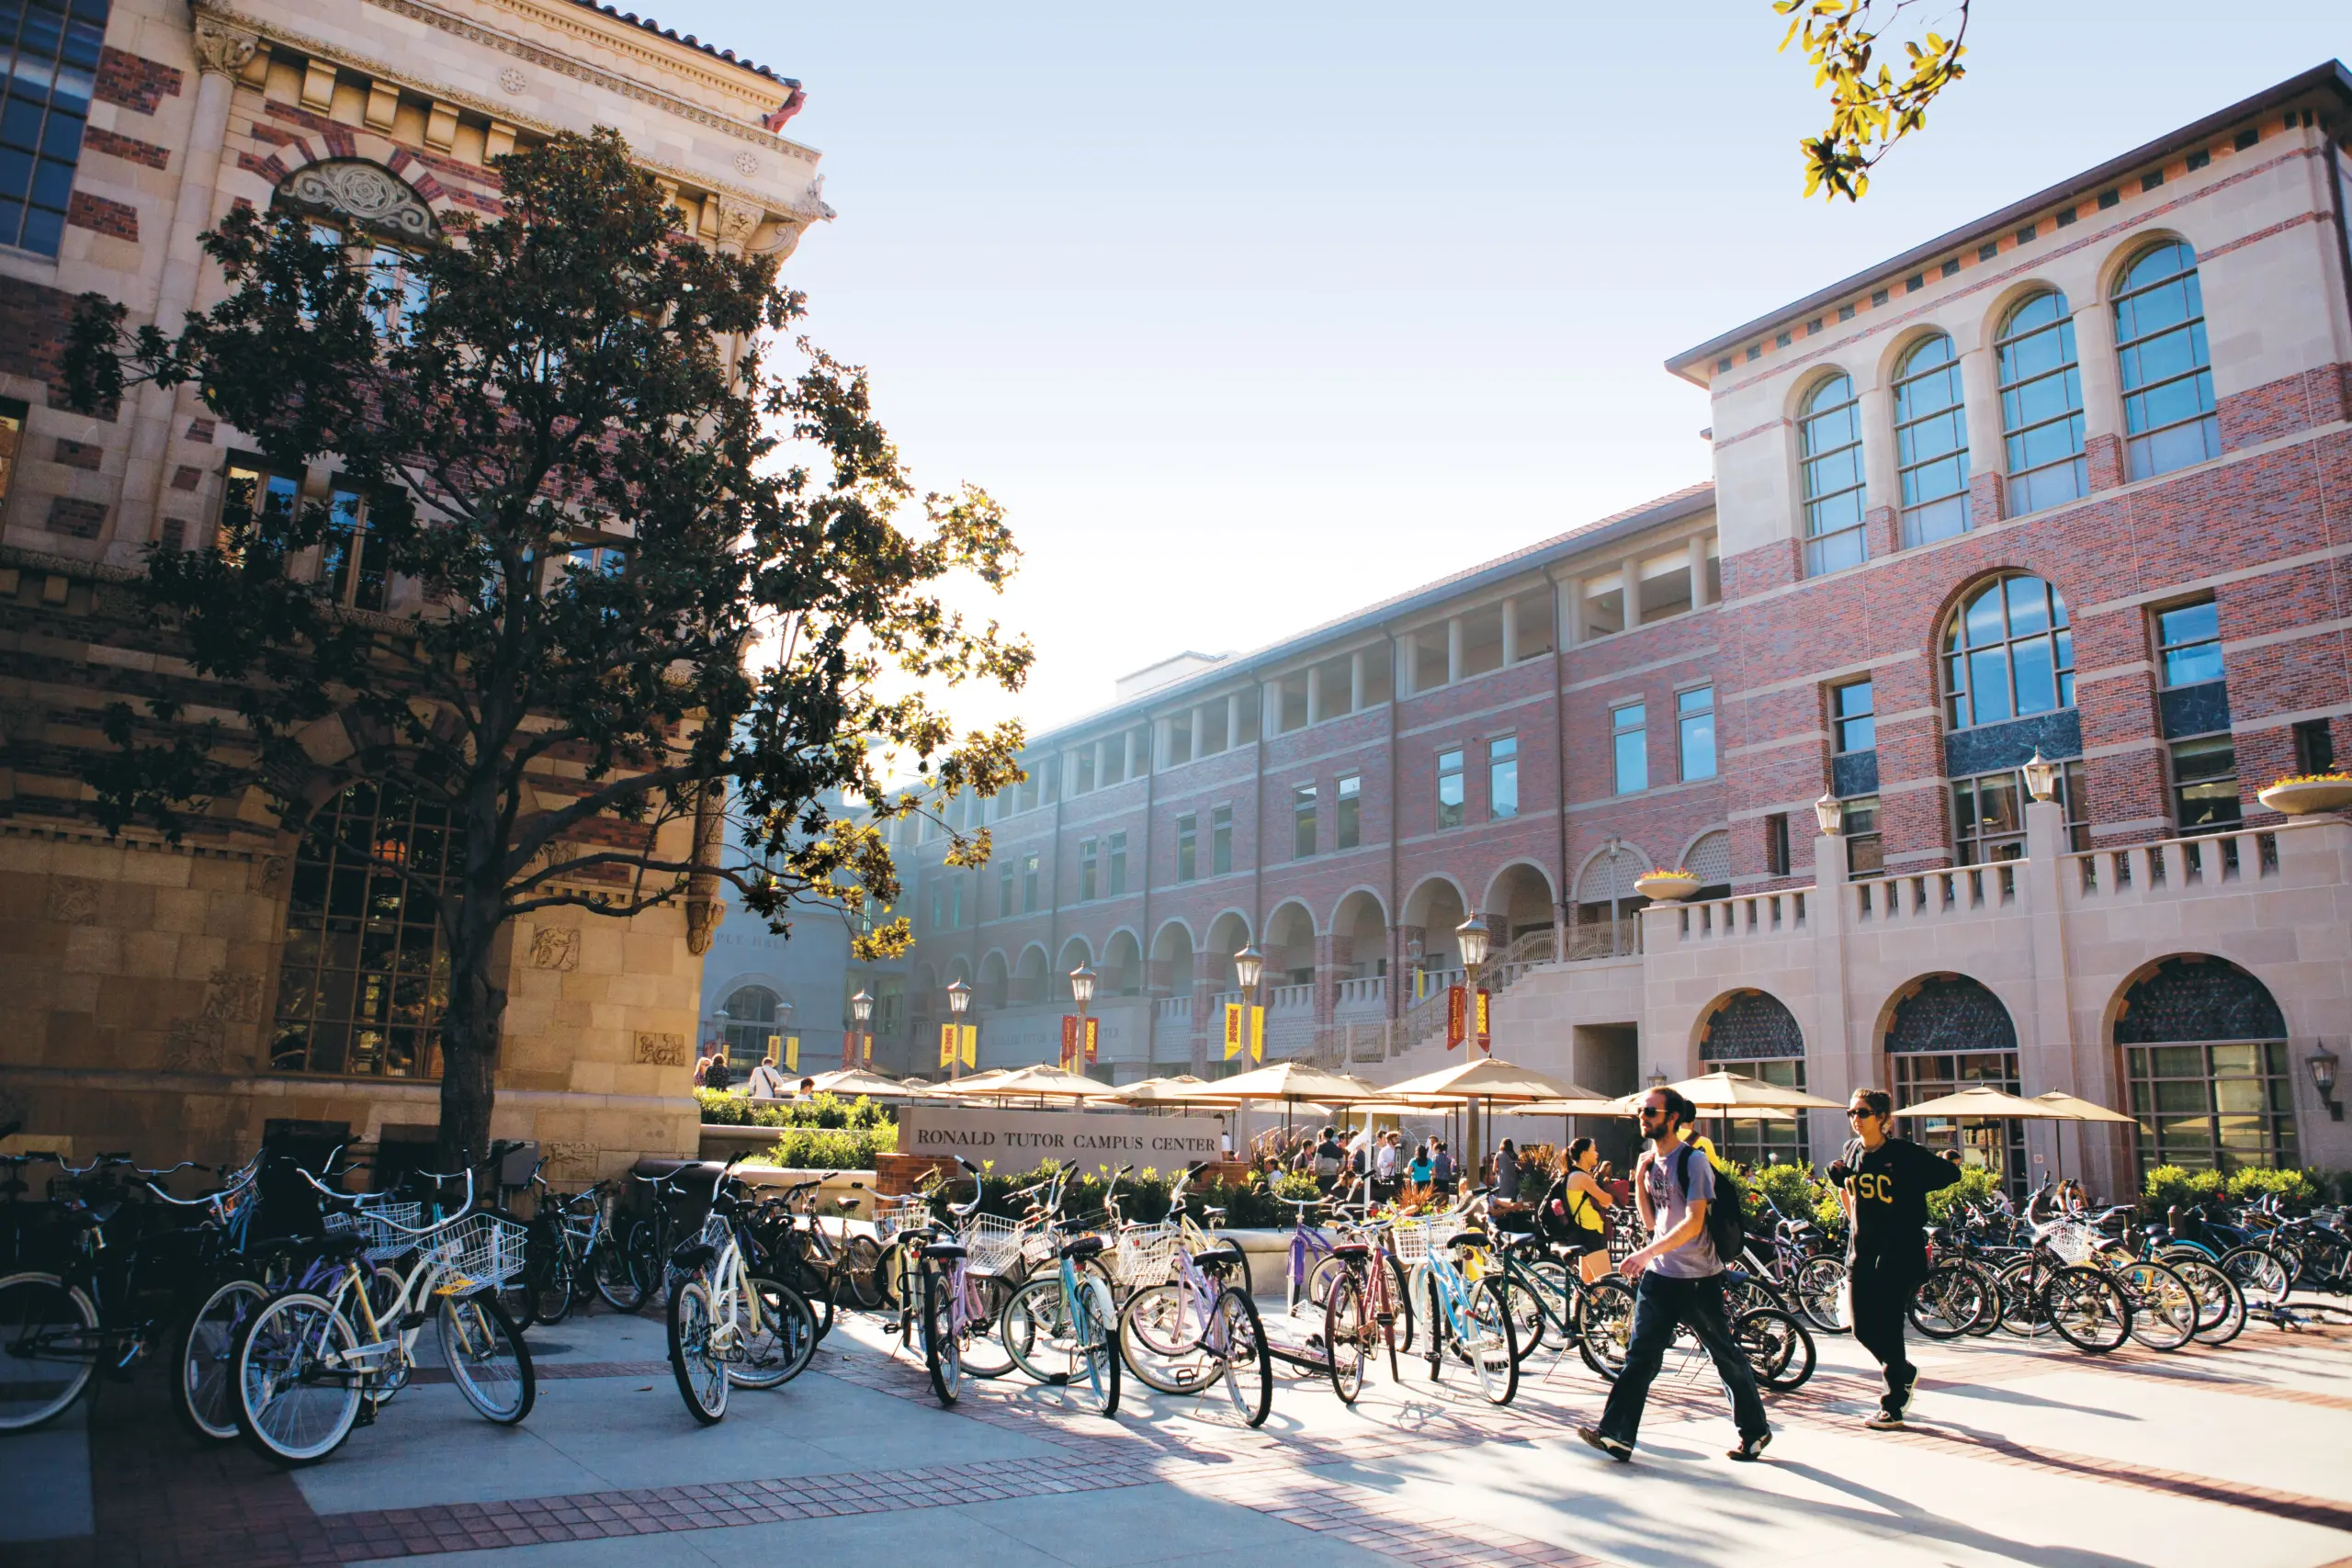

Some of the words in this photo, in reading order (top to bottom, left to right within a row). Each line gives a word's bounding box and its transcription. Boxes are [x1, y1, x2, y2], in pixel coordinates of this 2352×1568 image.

[717, 932, 744, 945] PLE
[917, 1129, 995, 1145] RONALD
[1004, 1132, 1065, 1147] TUTOR
[1073, 1134, 1143, 1150] CAMPUS
[1152, 1137, 1216, 1152] CENTER
